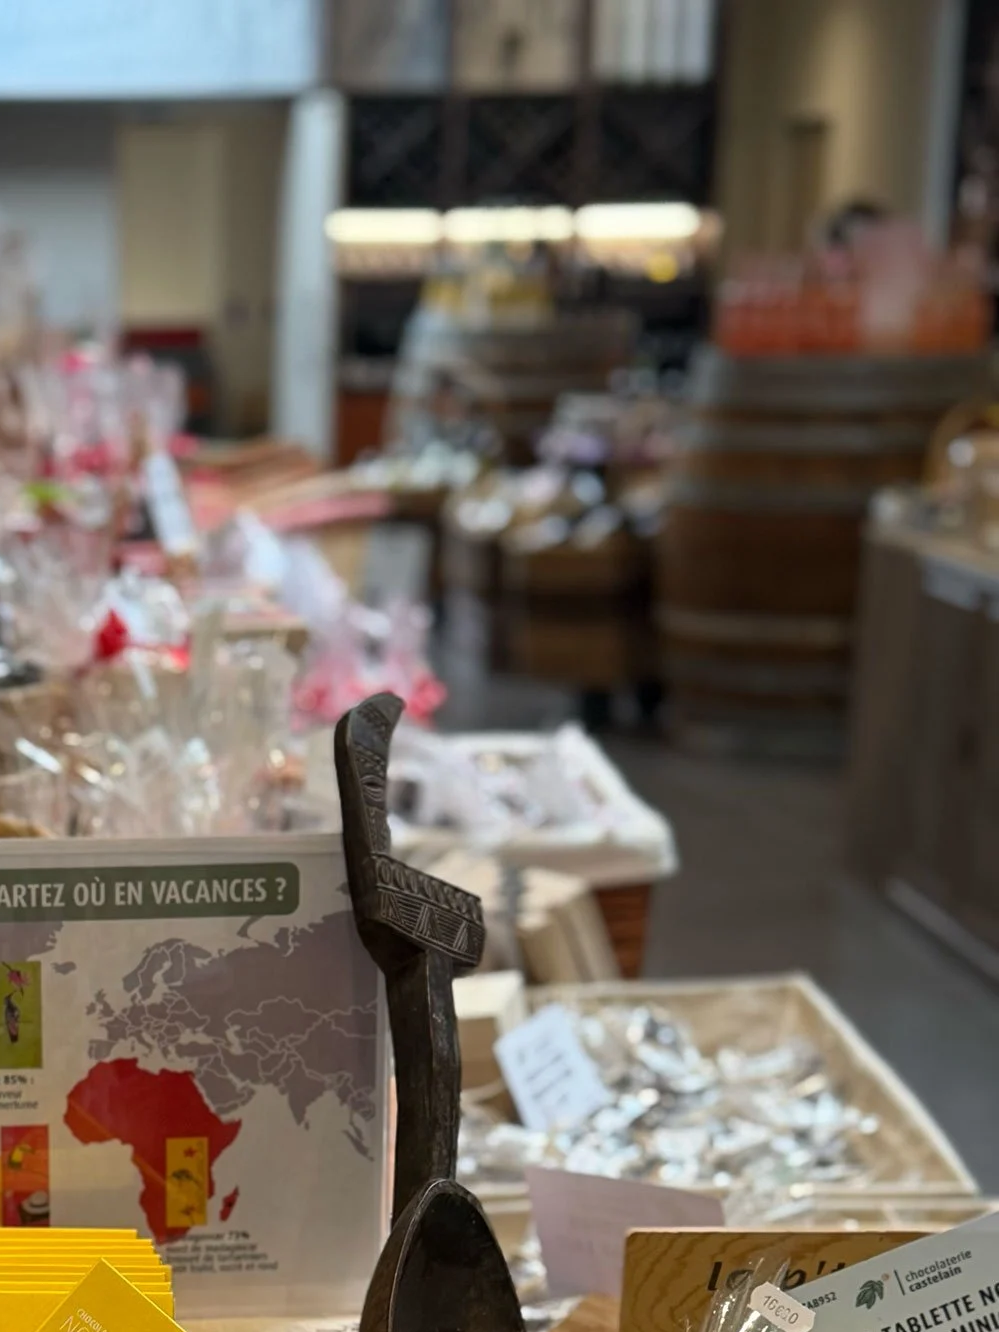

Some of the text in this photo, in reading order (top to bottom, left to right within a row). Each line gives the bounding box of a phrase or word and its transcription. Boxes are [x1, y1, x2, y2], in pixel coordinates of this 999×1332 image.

[73, 876, 106, 907] OÙ
[115, 880, 144, 906] EN
[151, 877, 268, 905] VACANCES
[275, 877, 287, 900] ?
[3, 1075, 28, 1085] 85%
[904, 1249, 973, 1282] chocolaterie
[908, 1266, 963, 1293] castelain
